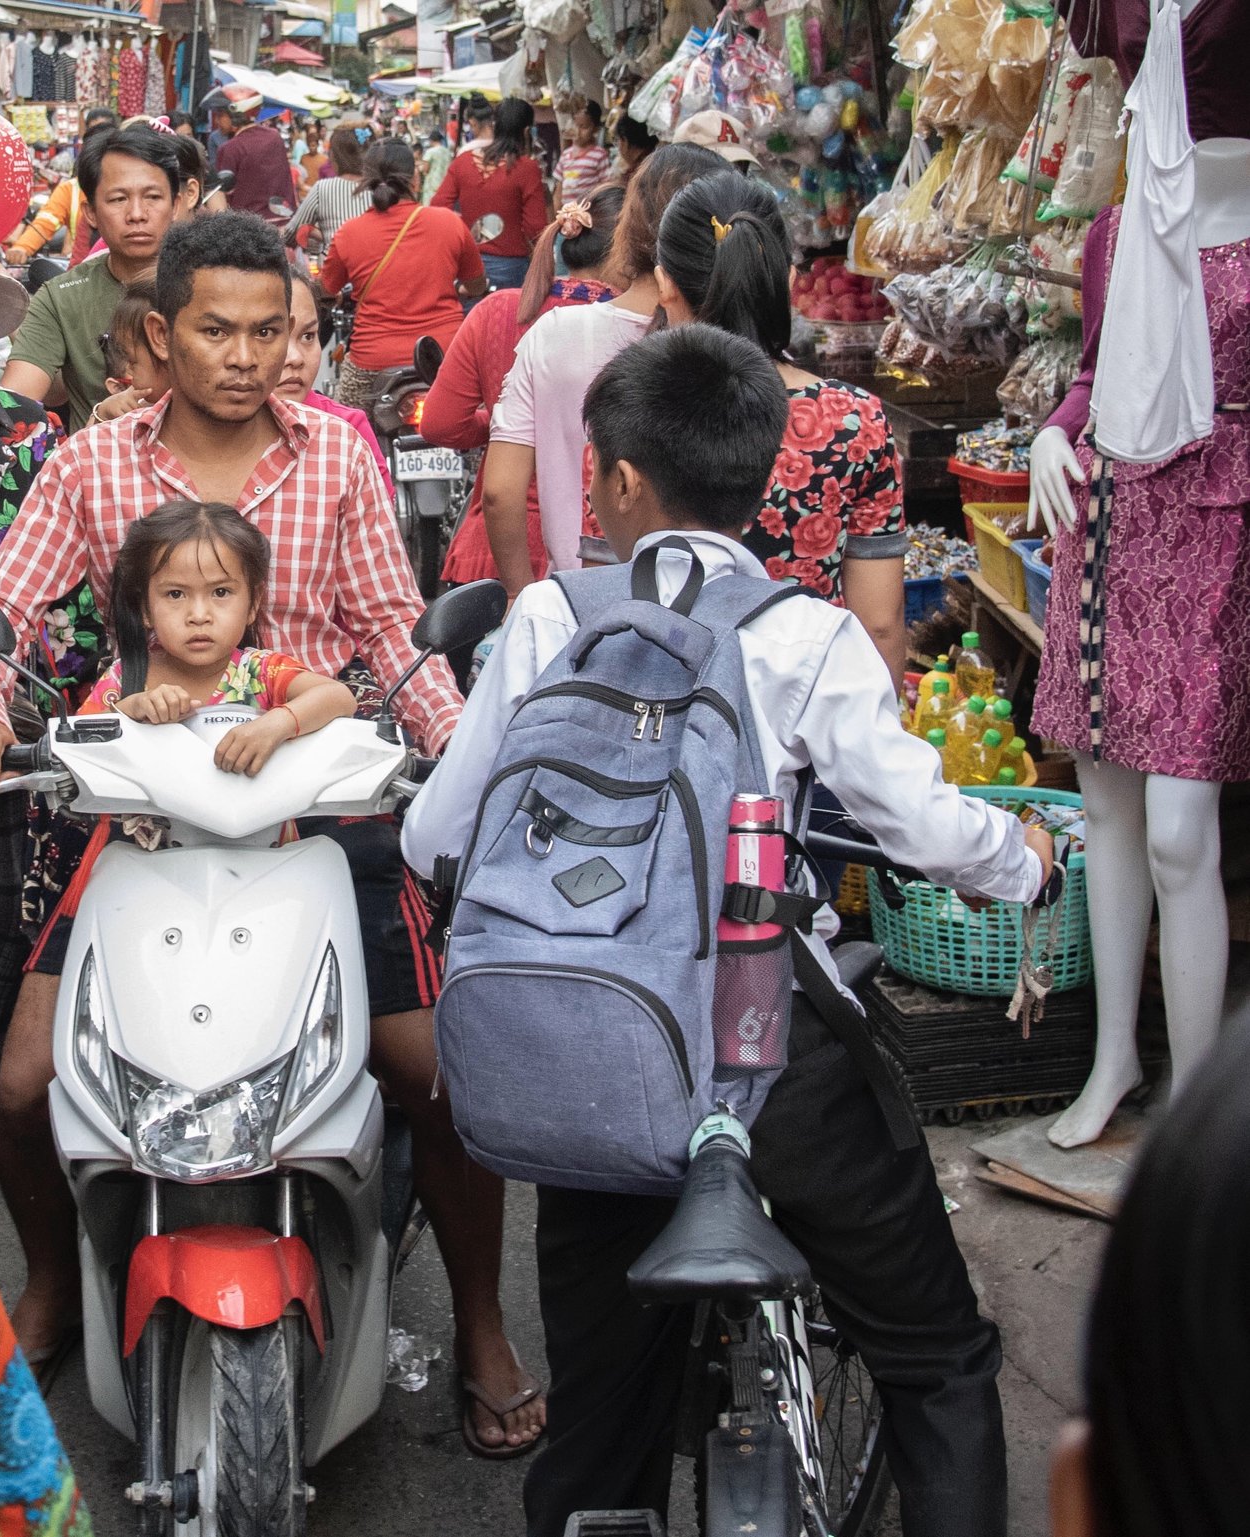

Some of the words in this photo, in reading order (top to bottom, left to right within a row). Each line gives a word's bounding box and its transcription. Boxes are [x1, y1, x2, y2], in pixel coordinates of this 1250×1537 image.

[717, 119, 740, 144] A
[399, 456, 461, 473] 1GD-4902
[204, 716, 253, 724] HONDA
